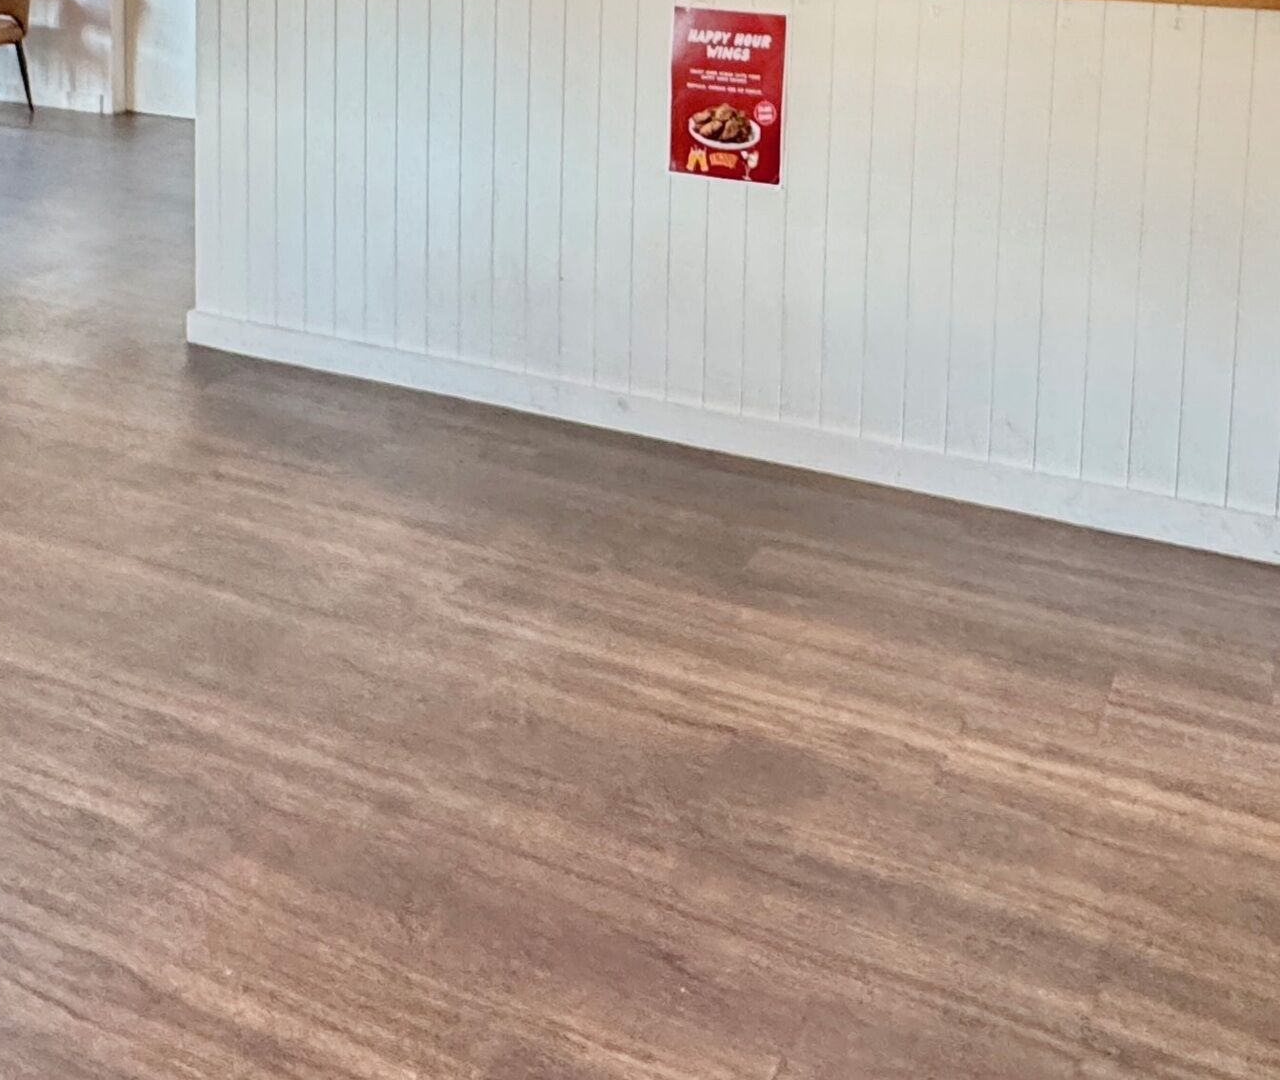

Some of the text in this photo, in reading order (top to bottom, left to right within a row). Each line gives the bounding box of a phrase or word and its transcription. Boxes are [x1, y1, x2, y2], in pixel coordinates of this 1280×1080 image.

[687, 28, 772, 50] HAPPY HOUR
[706, 44, 751, 62] WINGS
